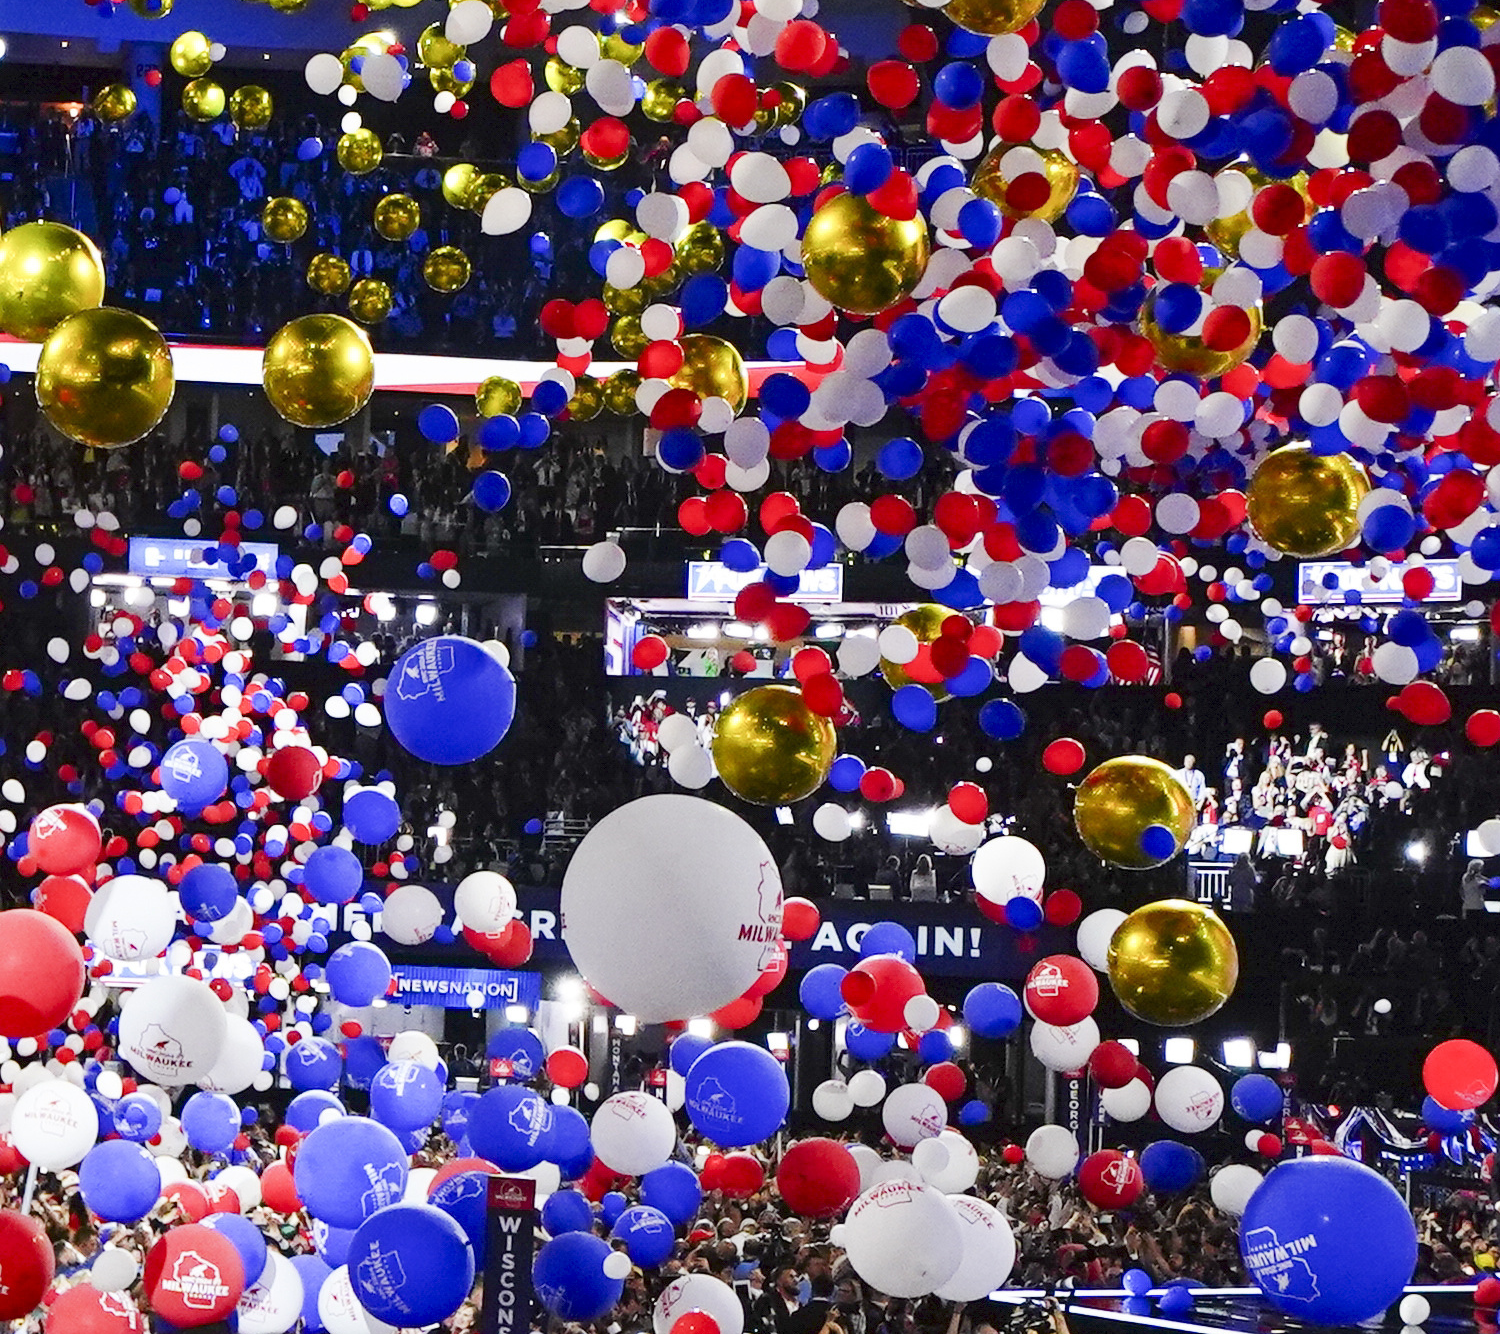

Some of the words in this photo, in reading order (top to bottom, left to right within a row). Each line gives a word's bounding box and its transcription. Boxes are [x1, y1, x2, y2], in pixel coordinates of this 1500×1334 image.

[810, 921, 982, 959] AGIN!
[130, 1046, 194, 1068] MILWAUKEE
[24, 1112, 79, 1128] MILWAUKEE
[1069, 1080, 1080, 1142] GEORGI
